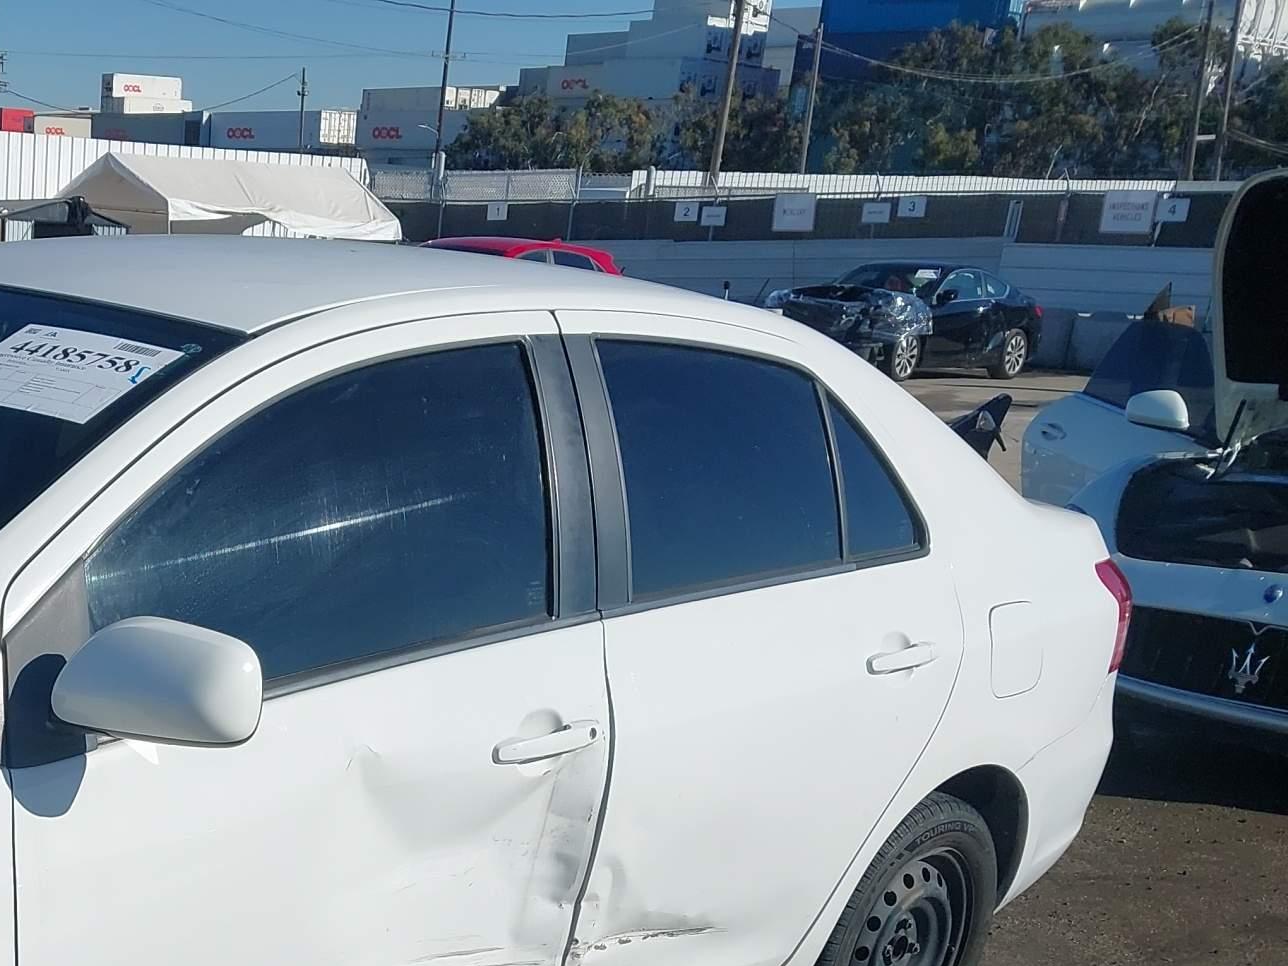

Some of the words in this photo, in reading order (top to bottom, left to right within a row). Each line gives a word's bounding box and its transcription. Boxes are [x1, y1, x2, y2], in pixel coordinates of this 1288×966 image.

[123, 84, 142, 93] OOCL
[44, 126, 65, 135] OOCL
[226, 127, 255, 139] OOCL
[372, 126, 403, 139] OOCL
[682, 207, 691, 217] 2
[908, 200, 916, 212] 3
[1167, 203, 1177, 216] 4
[10, 340, 140, 373] 44185758
[915, 821, 961, 845] TOURING
